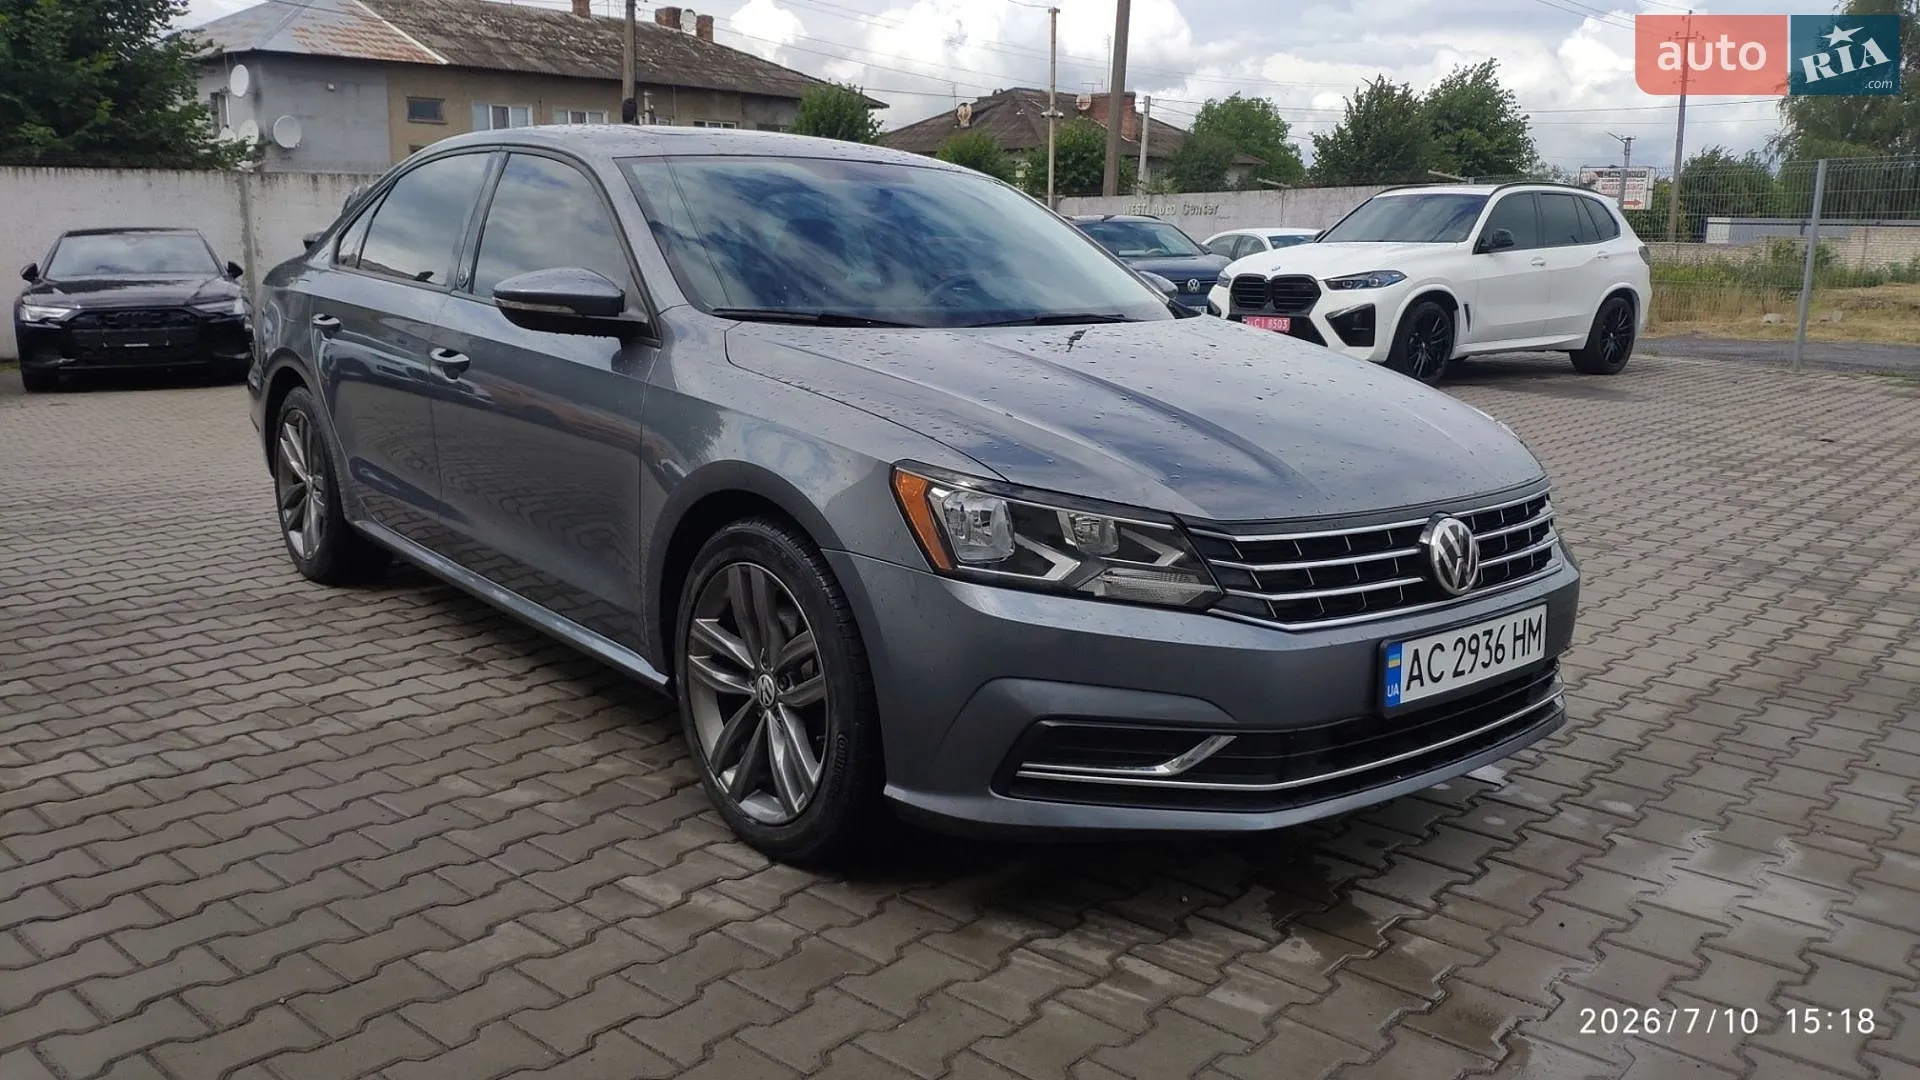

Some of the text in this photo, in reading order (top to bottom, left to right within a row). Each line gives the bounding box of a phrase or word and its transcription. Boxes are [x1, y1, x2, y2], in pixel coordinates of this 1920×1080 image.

[1387, 614, 1543, 697] UA AC 2936 HM
